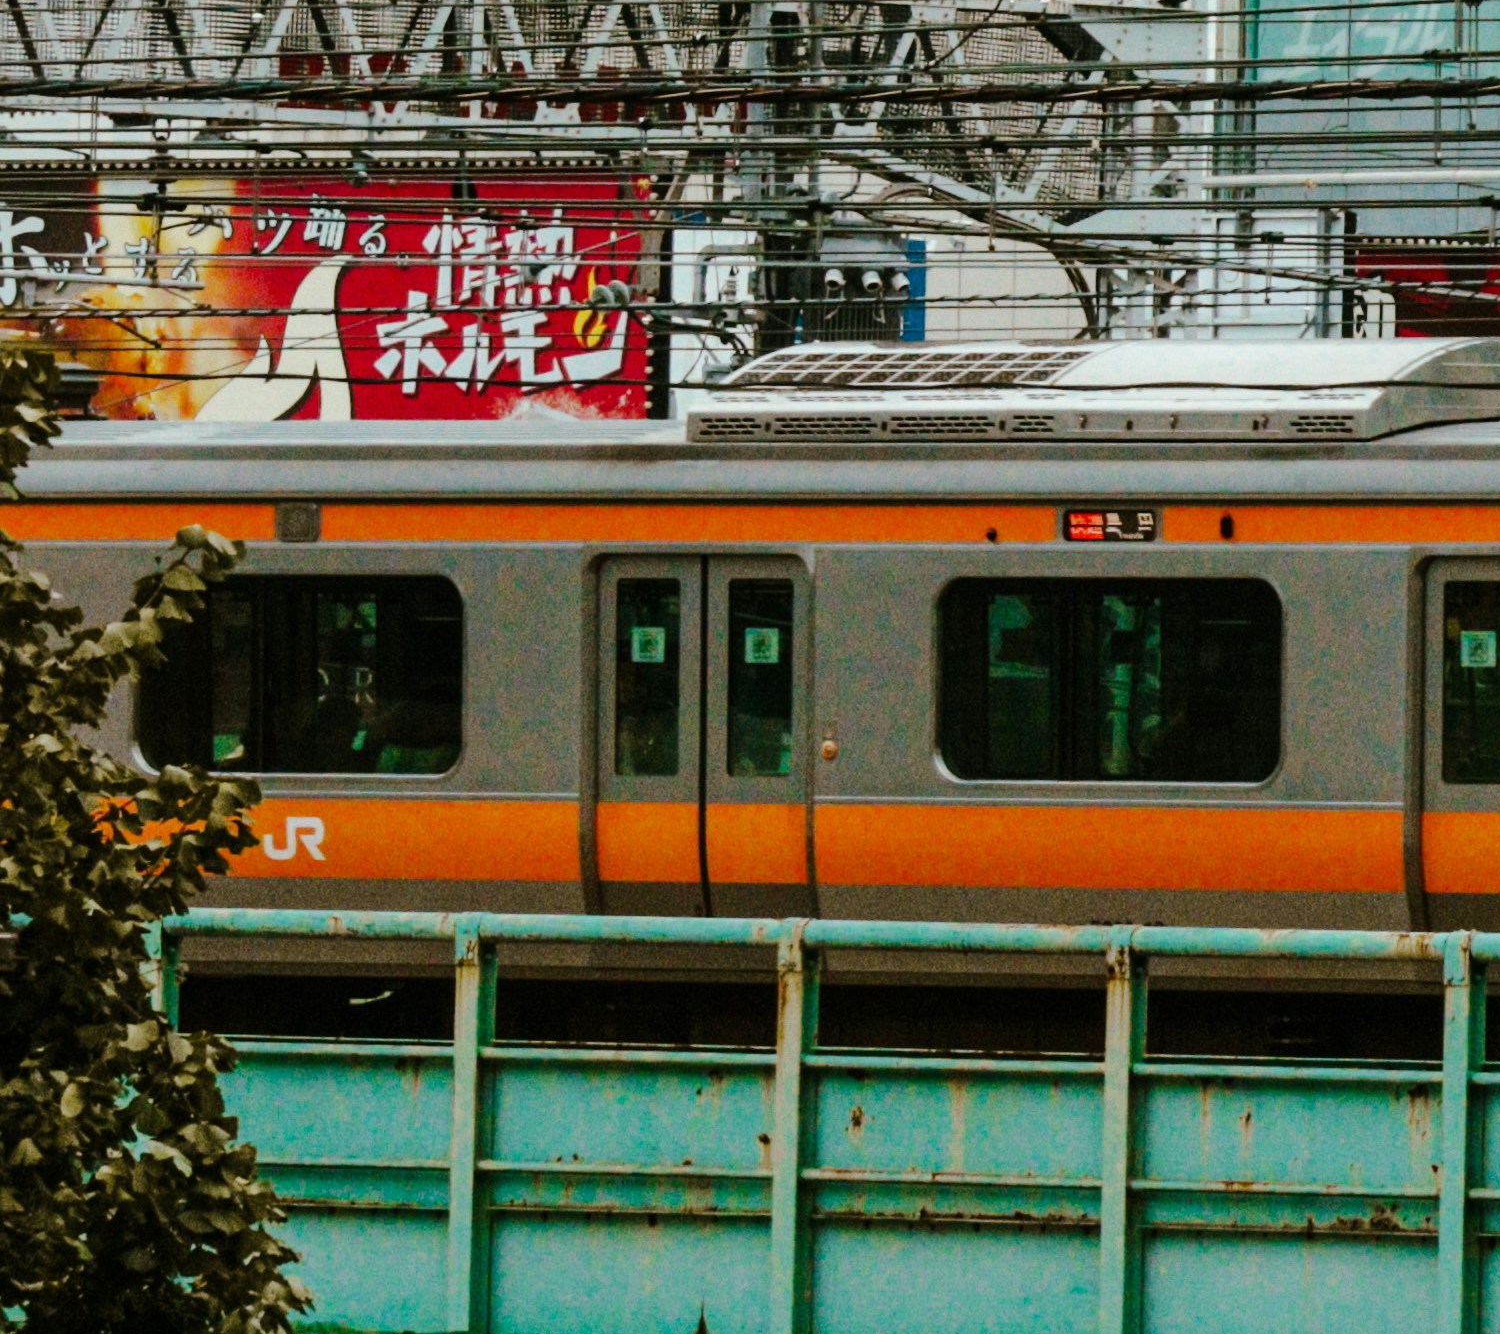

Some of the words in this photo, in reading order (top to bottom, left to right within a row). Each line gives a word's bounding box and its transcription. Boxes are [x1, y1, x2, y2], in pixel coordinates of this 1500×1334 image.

[373, 291, 630, 395] ホルモン
[263, 816, 326, 862] JR
